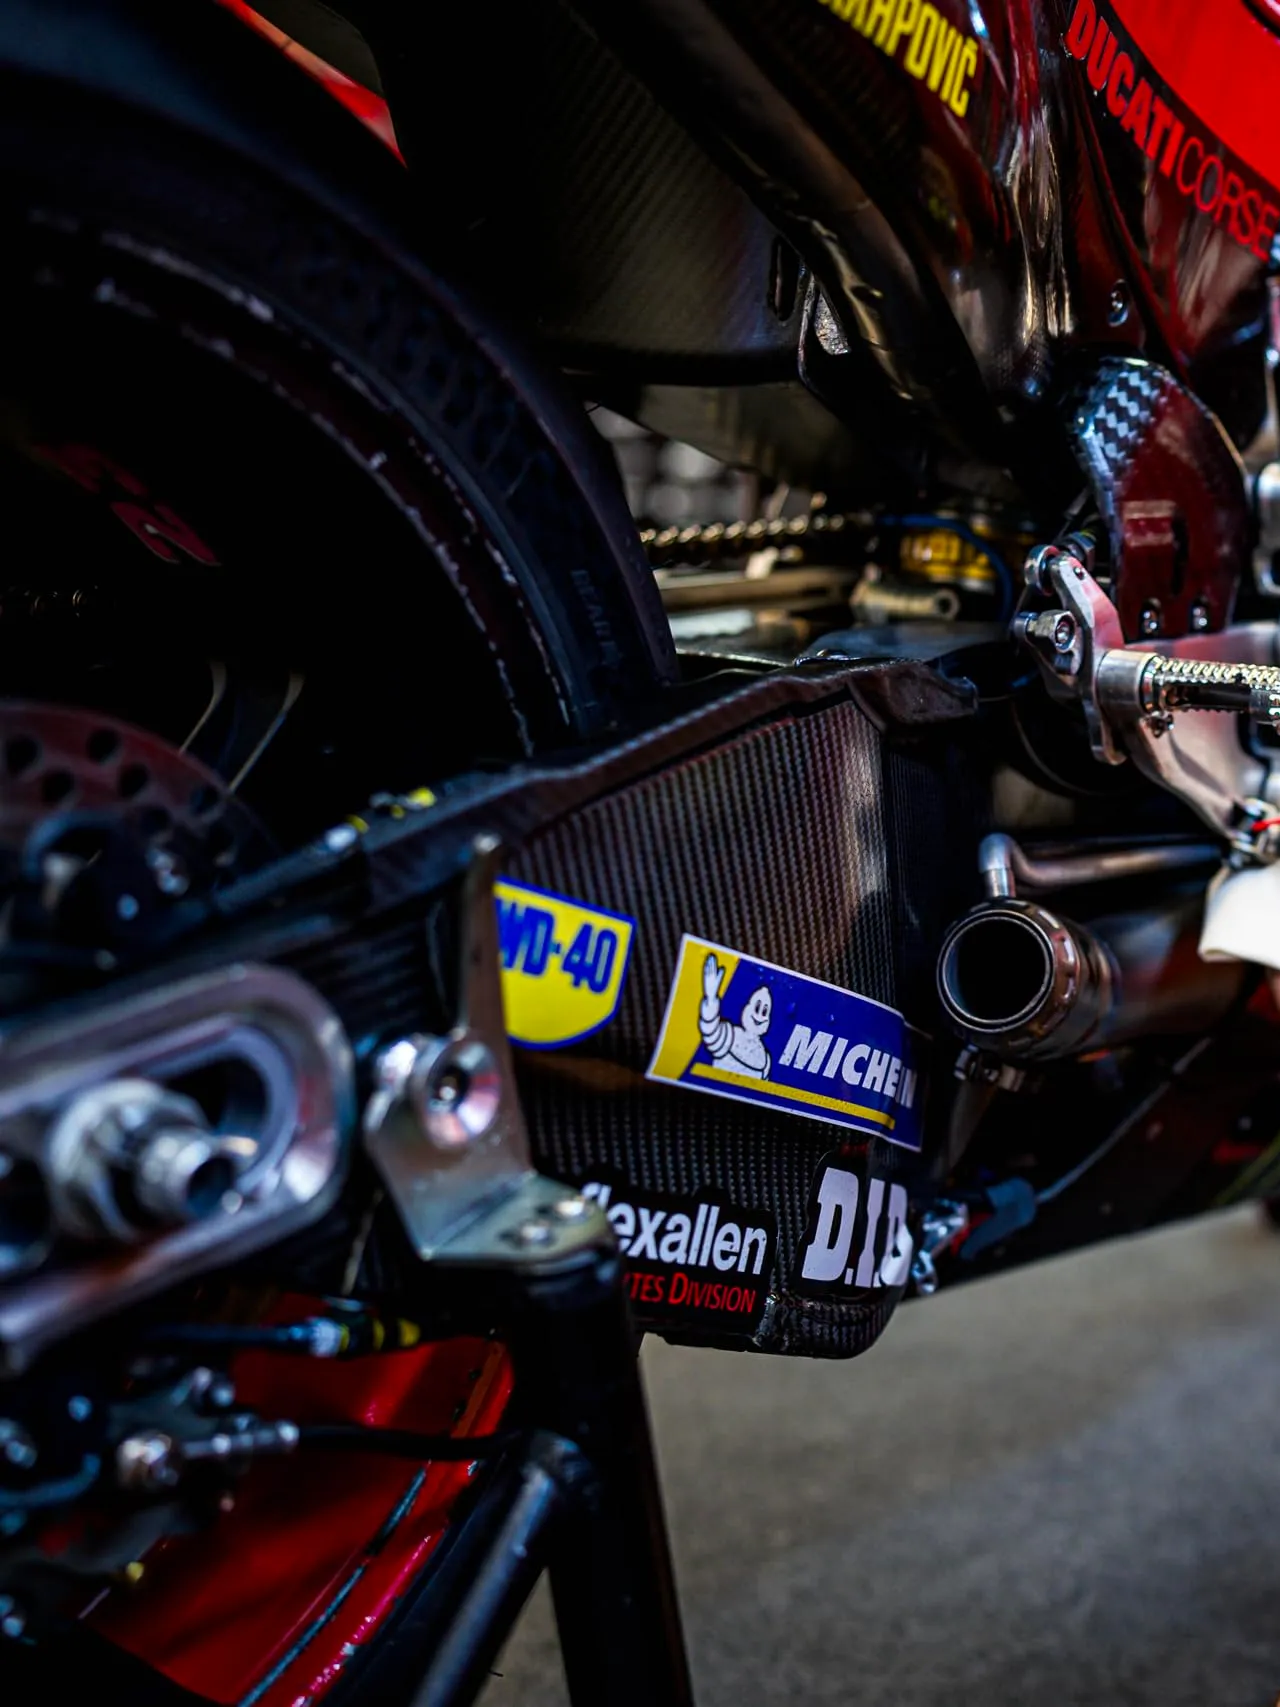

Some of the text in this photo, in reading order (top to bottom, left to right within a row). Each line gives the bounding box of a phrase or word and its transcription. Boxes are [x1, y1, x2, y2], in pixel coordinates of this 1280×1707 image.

[494, 896, 618, 994] WD-40
[778, 1023, 917, 1110] MICHEIN
[582, 1181, 768, 1276] exallen
[668, 1271, 757, 1314] DIVISION
